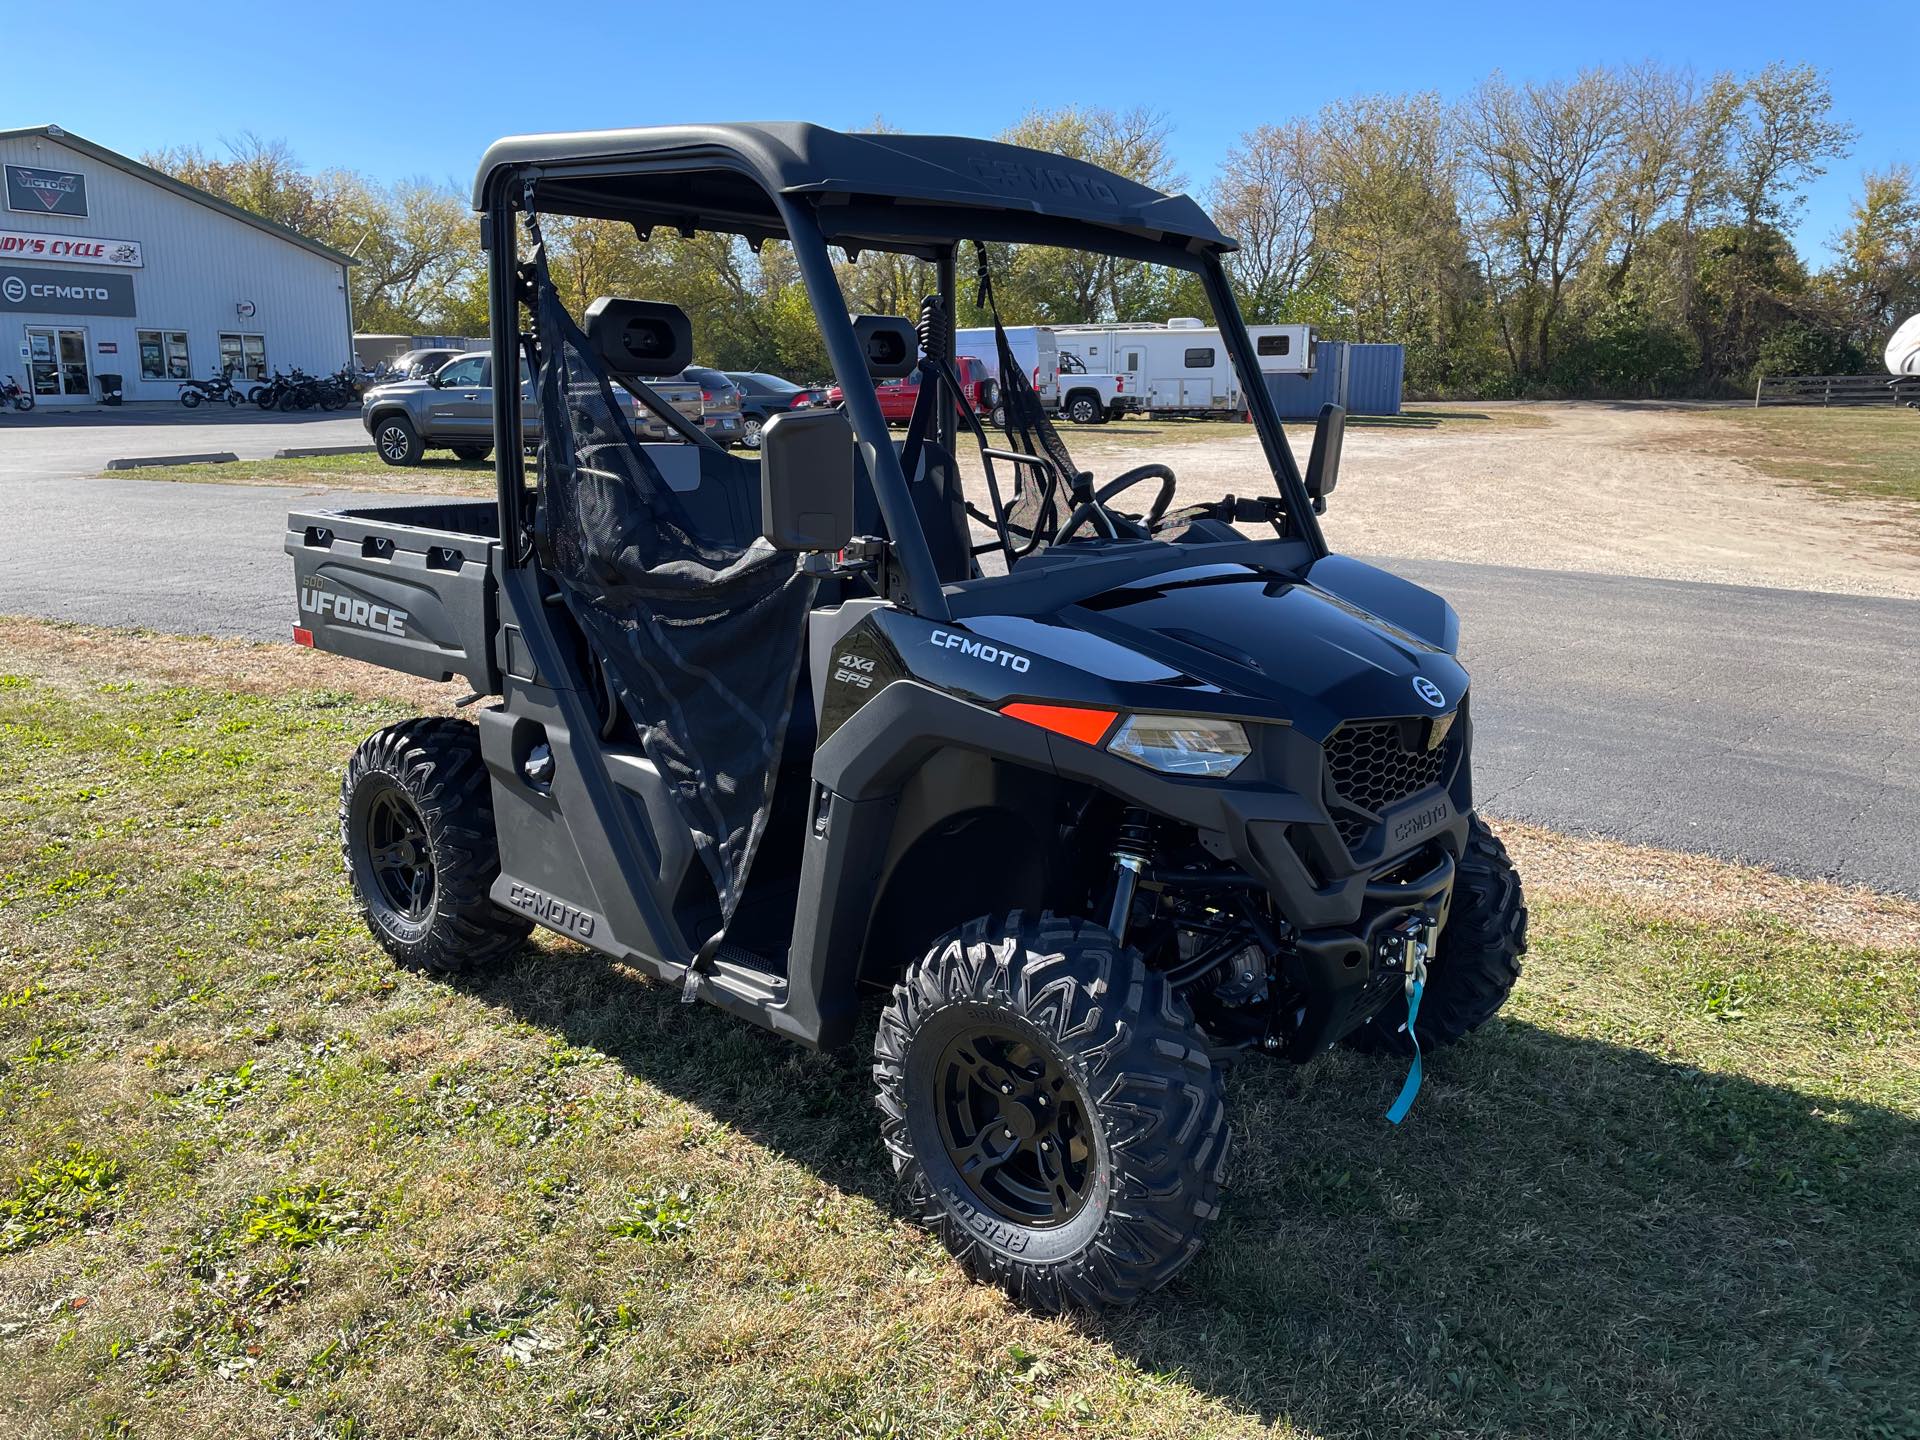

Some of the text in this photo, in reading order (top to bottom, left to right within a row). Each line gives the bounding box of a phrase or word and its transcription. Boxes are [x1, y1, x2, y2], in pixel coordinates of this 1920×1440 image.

[17, 176, 76, 192] VICTORY
[967, 157, 1120, 208] CFMOTO
[52, 241, 105, 257] CYCLE
[30, 284, 109, 300] CFMOTO
[302, 588, 408, 637] UFORCE
[838, 654, 876, 673] 4X4
[930, 629, 1031, 674] CFMOTO
[833, 669, 874, 689] EPS
[1393, 802, 1448, 842] CFMOTO
[509, 881, 596, 939] CFMOTO
